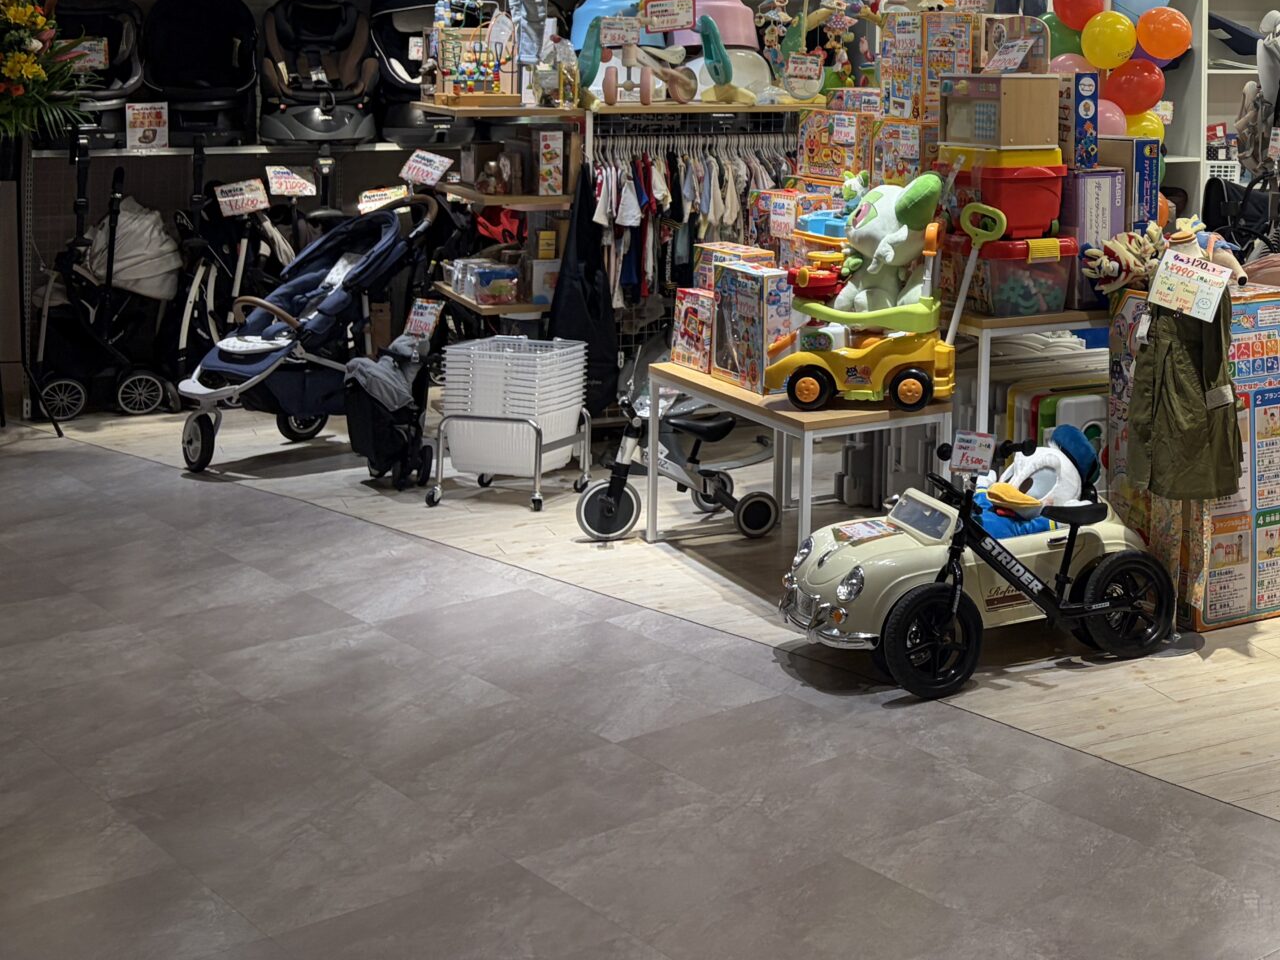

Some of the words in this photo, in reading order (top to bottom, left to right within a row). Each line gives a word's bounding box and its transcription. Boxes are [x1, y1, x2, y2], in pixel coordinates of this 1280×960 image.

[1094, 180, 1103, 244] 光ナビゲーションキー
[1115, 175, 1123, 207] CASIO
[981, 536, 1045, 595] STRIDER
